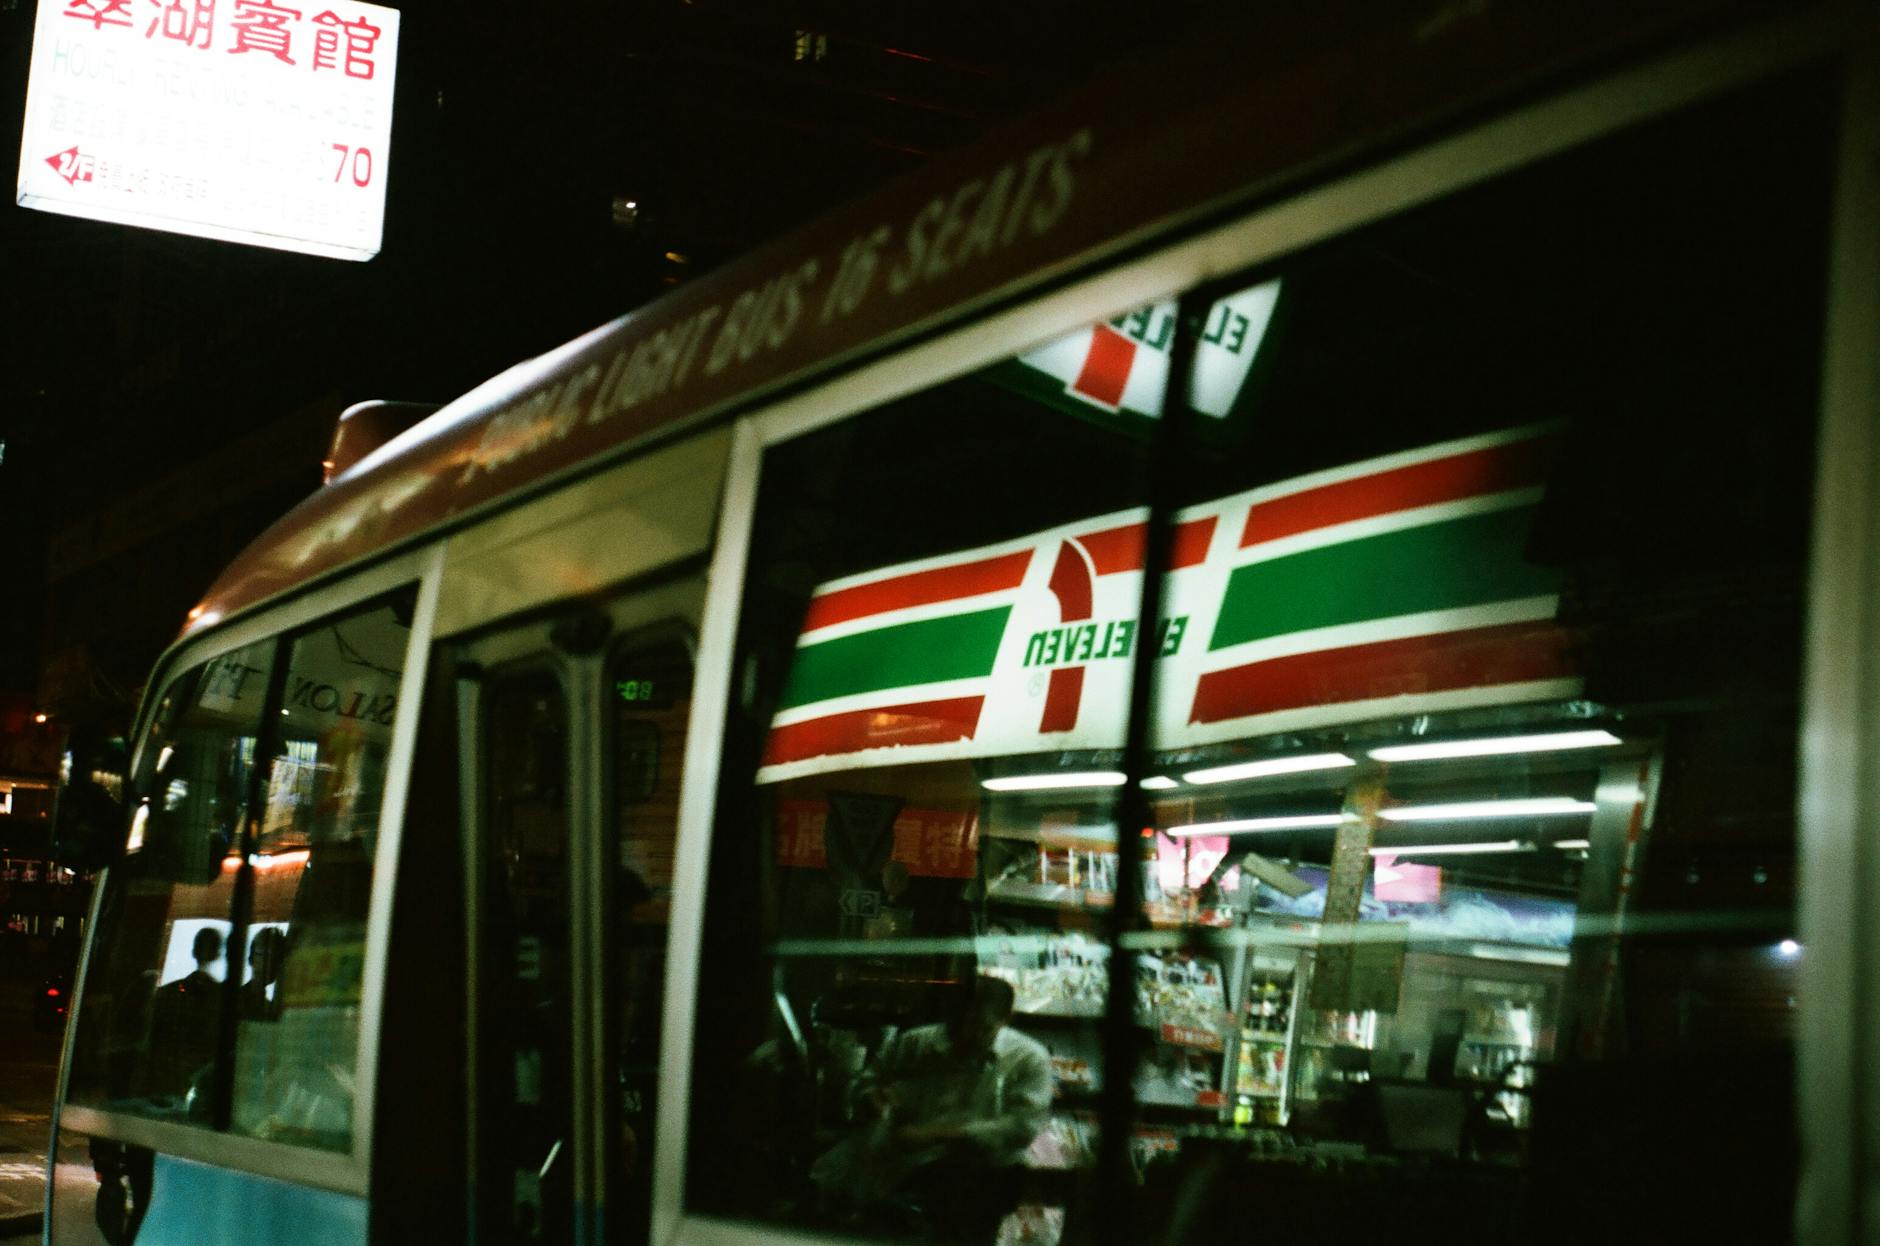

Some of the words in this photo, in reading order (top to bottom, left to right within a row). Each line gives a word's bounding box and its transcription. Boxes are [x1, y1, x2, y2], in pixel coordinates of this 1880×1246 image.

[331, 142, 373, 188] 70
[703, 257, 818, 376] BUS
[887, 127, 1093, 296] SEATS
